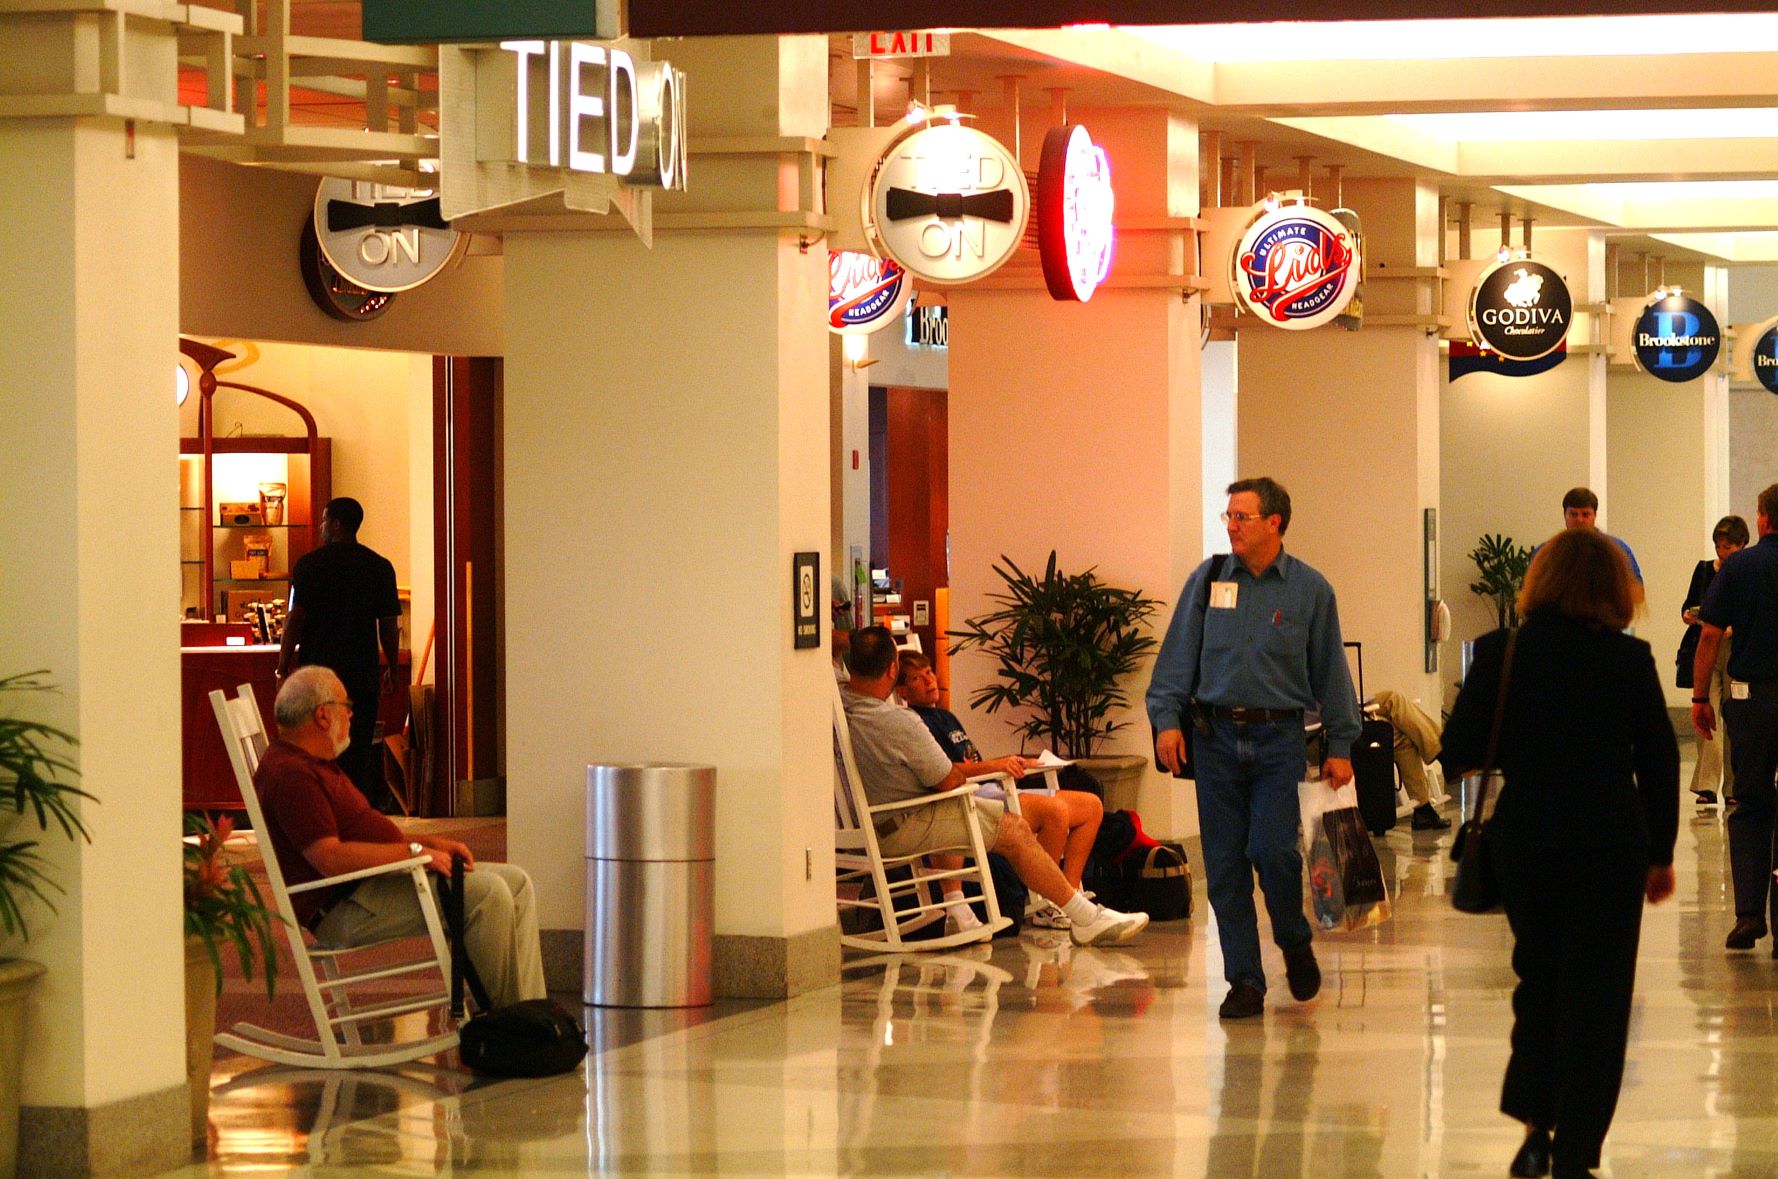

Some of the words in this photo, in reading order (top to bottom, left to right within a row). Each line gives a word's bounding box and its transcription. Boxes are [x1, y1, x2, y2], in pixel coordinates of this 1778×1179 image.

[499, 40, 639, 176] TIED
[899, 153, 1005, 190] TED
[361, 228, 421, 265] ON
[918, 220, 986, 259] ON
[1259, 226, 1306, 256] ULTIMATE
[1240, 231, 1352, 304] Lids
[848, 289, 890, 317] HEADGEAR
[1291, 283, 1334, 310] HEADGEAR
[1482, 308, 1563, 325] GODIVA
[1504, 326, 1545, 335] Chocolatier
[1639, 333, 1715, 346] Brookstone
